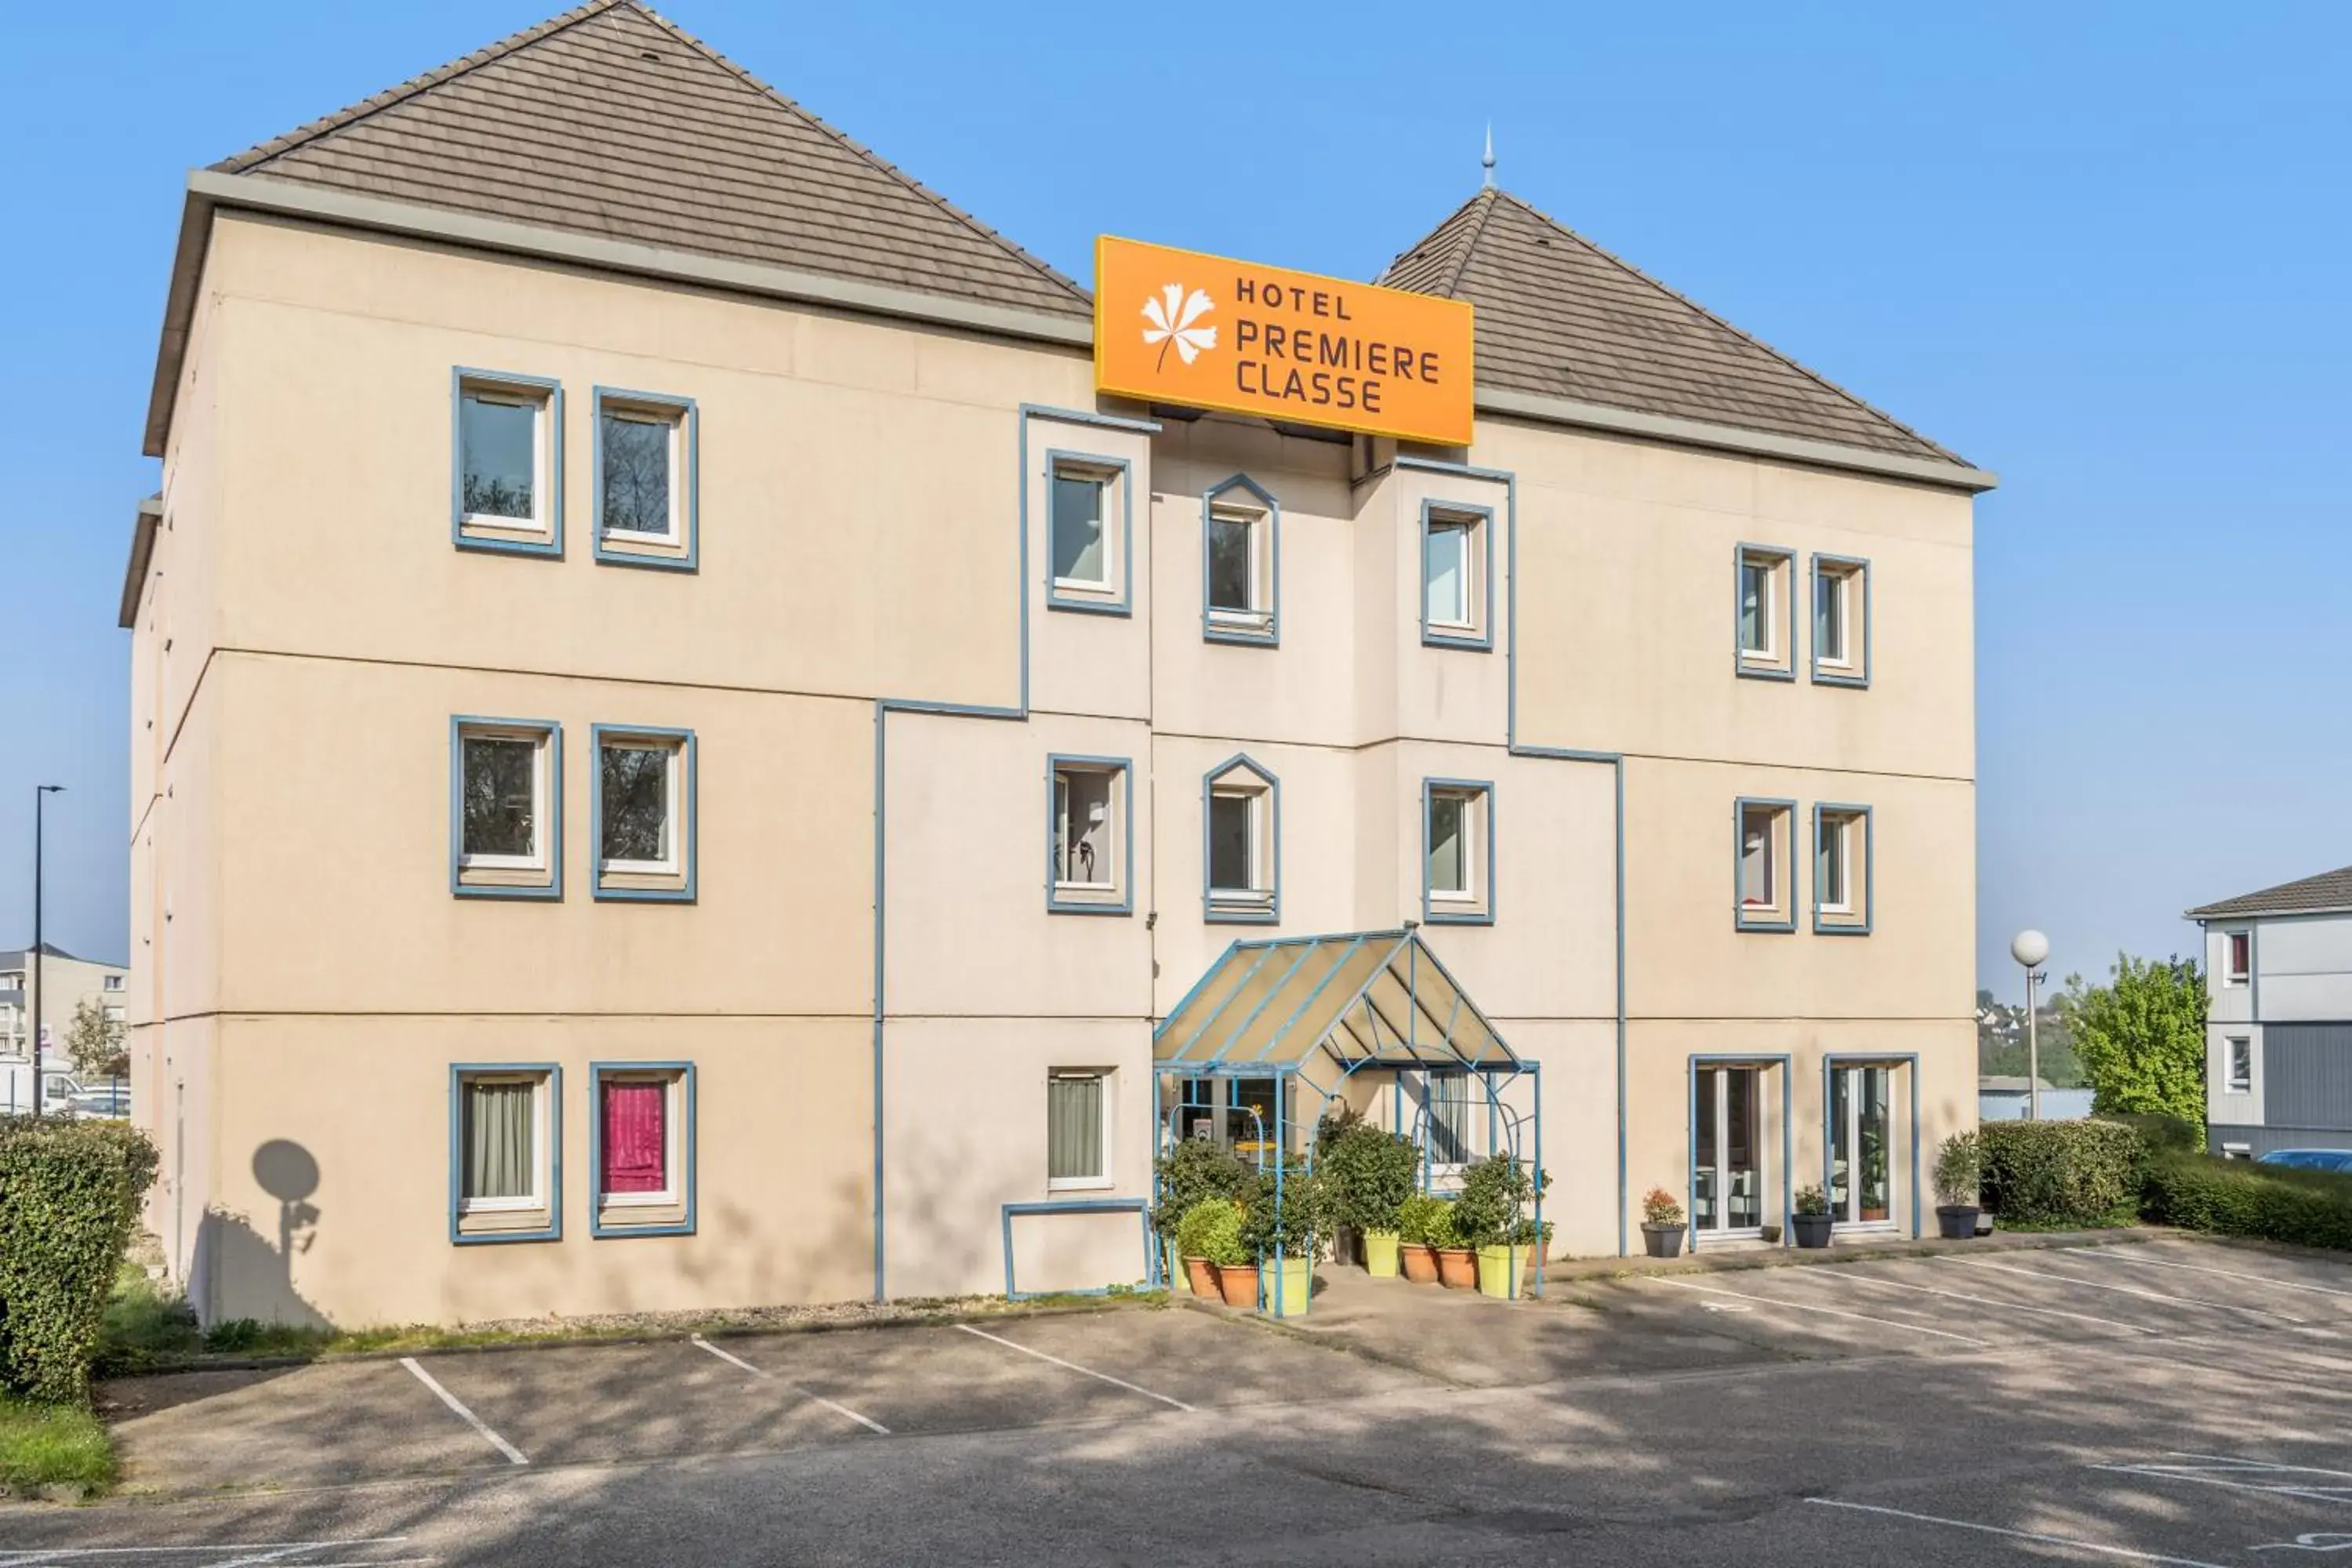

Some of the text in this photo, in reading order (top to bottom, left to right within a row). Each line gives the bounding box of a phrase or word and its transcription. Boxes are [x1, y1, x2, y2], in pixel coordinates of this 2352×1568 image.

[1236, 278, 1352, 321] HOTEL
[1236, 319, 1438, 385] PREMIERE
[1236, 360, 1381, 413] CLASSE
